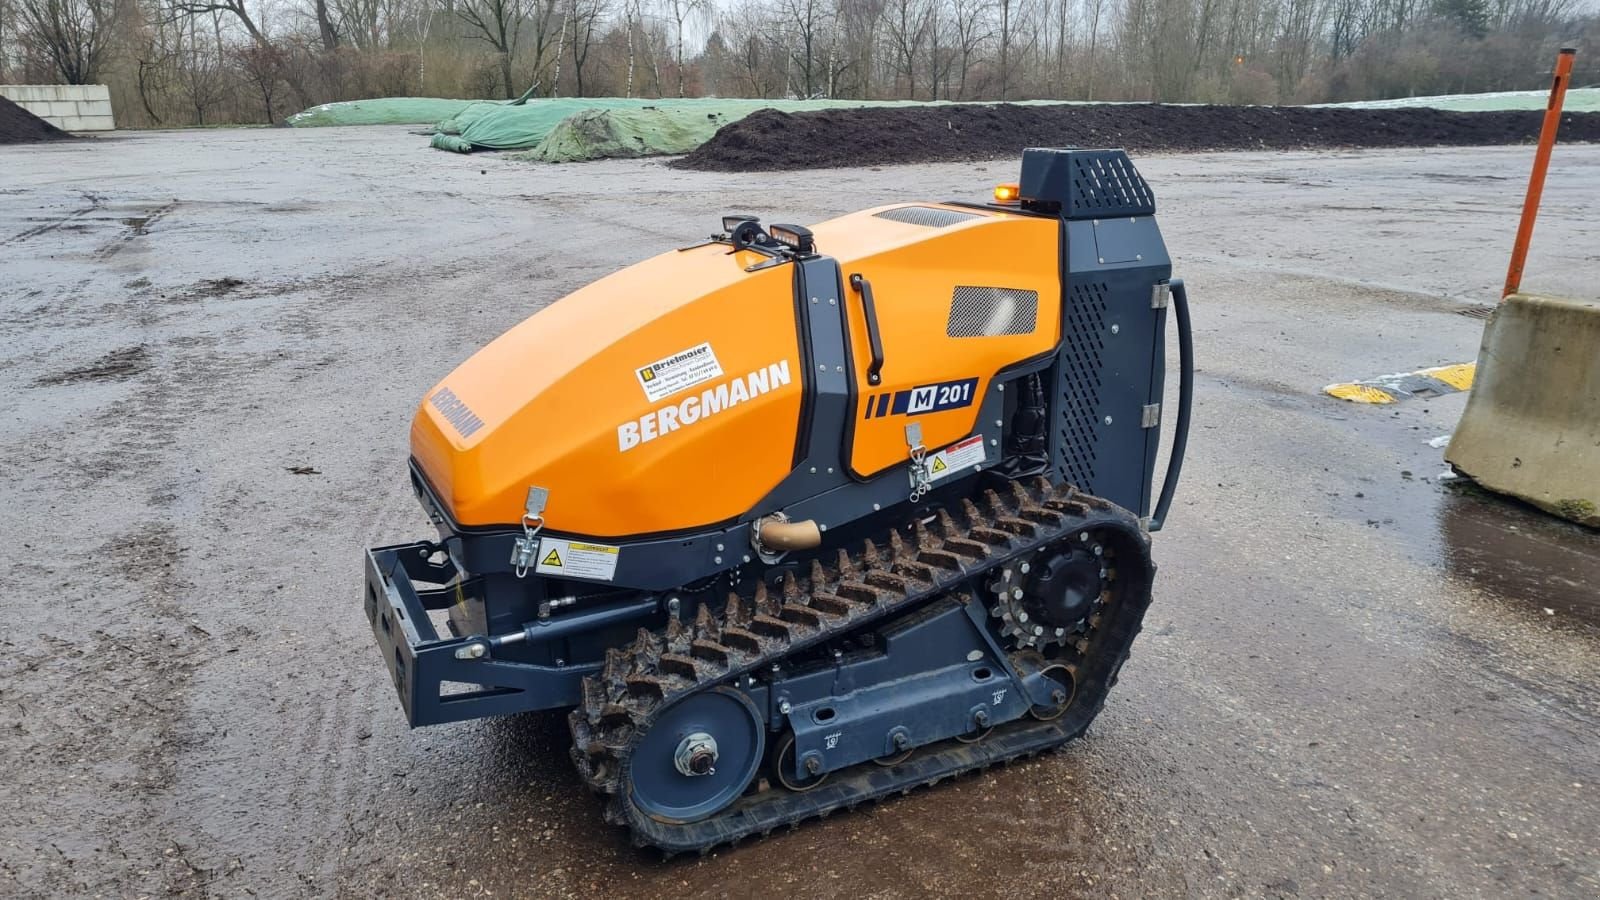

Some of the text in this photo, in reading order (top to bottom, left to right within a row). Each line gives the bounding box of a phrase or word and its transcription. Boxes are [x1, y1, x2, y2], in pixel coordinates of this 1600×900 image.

[653, 346, 708, 371] Brielmaier
[642, 369, 654, 381] B
[617, 359, 791, 453] BERGMANN
[915, 383, 970, 409] M 201
[431, 386, 486, 439] BERGMANN
